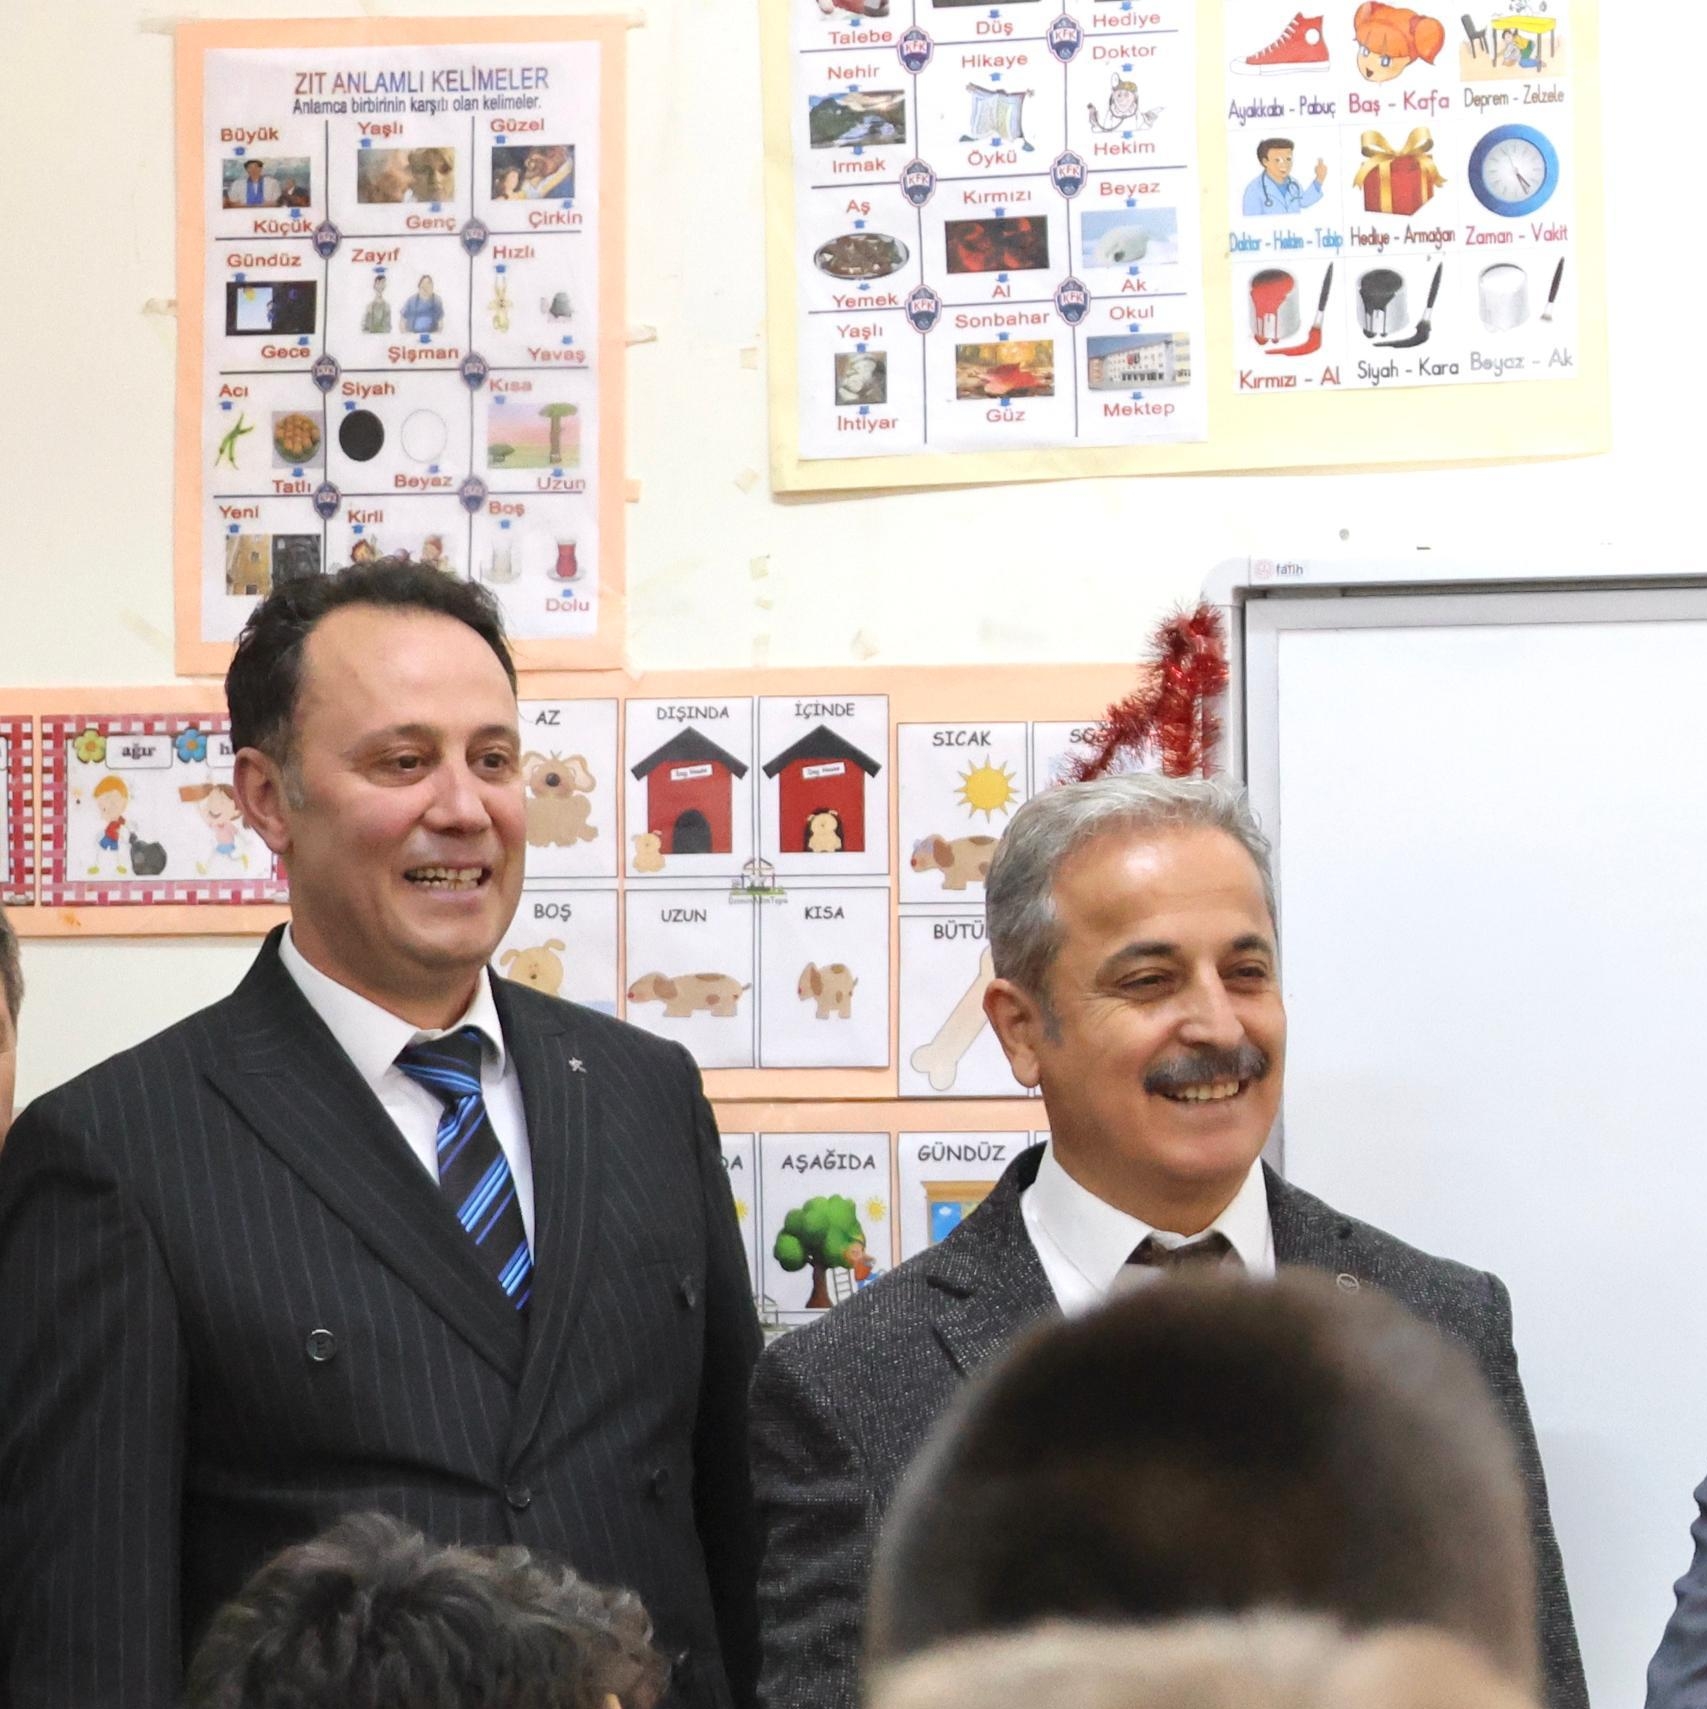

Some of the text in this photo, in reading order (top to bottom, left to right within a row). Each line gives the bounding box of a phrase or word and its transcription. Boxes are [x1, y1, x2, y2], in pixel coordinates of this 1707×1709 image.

[975, 20, 1014, 37] Düş
[1092, 11, 1161, 29] Hediye
[828, 29, 893, 45] Talebe
[1092, 44, 1157, 60] Doktor
[961, 53, 1029, 71] Hikaye
[294, 66, 549, 95] ZIT ANLAMLI KELİMELER
[827, 64, 880, 80] Nehir
[1349, 90, 1450, 118] Baş Kafa
[1464, 83, 1564, 108] Deprem Zelzele
[293, 98, 347, 115] Anlamca
[453, 95, 479, 110] olan
[1299, 95, 1336, 118] Pabuç
[357, 121, 403, 137] Yaşlı
[490, 118, 545, 132] Güzel
[220, 127, 279, 144] Büyük
[1094, 141, 1156, 156] Hekim
[832, 158, 886, 174] Irmak
[967, 151, 1018, 168] Öykü
[963, 189, 1032, 206] Kırmızı
[1099, 180, 1161, 198] Beyaz
[846, 200, 871, 216] Aş
[253, 219, 313, 237] Küçük
[406, 215, 457, 231] Genç
[529, 211, 583, 228] Çirkin
[1351, 225, 1456, 253] Hediye Armağan
[1466, 223, 1568, 246] Zaman Vakit
[352, 247, 400, 265] Zayıf
[493, 244, 535, 260] Hızlı
[227, 253, 301, 269] Gündüz
[992, 284, 1011, 298] Al
[1121, 278, 1147, 293] Ak
[833, 292, 899, 309] Yemek
[955, 311, 1050, 329] Sonbahar
[1109, 305, 1155, 321] Okul
[837, 323, 883, 342] Yaşlı
[261, 344, 311, 359] Gece
[388, 346, 459, 364] Şişman
[527, 347, 586, 364] Yavaş
[1357, 357, 1459, 385] Siyah Kara
[1470, 349, 1573, 378] Beyaz Ak
[489, 378, 532, 392] Kısa
[1239, 366, 1341, 389] Kırmızı Al
[218, 383, 248, 398] Acı
[342, 382, 395, 398] Siyah
[985, 408, 1026, 424] Güz
[1103, 401, 1175, 419] Mektep
[272, 479, 311, 494] Tatlı
[394, 474, 453, 491] Beyaz
[537, 476, 586, 491] Uzun
[219, 505, 259, 521] Yeni
[348, 510, 383, 523] Kirli
[488, 501, 525, 517] Boş
[545, 598, 590, 613] Dolu
[535, 709, 561, 726] AZ
[656, 705, 730, 722] DIŞINDA
[795, 700, 856, 721] İÇİNDE
[933, 730, 993, 748] SICAK
[122, 742, 156, 760] ağır
[534, 903, 572, 922] BOŞ
[661, 907, 707, 924] UZUN
[804, 904, 845, 921] KISA
[781, 1149, 876, 1172] AŞAĞIDA
[918, 1142, 1006, 1163] GÜNDÜZ
